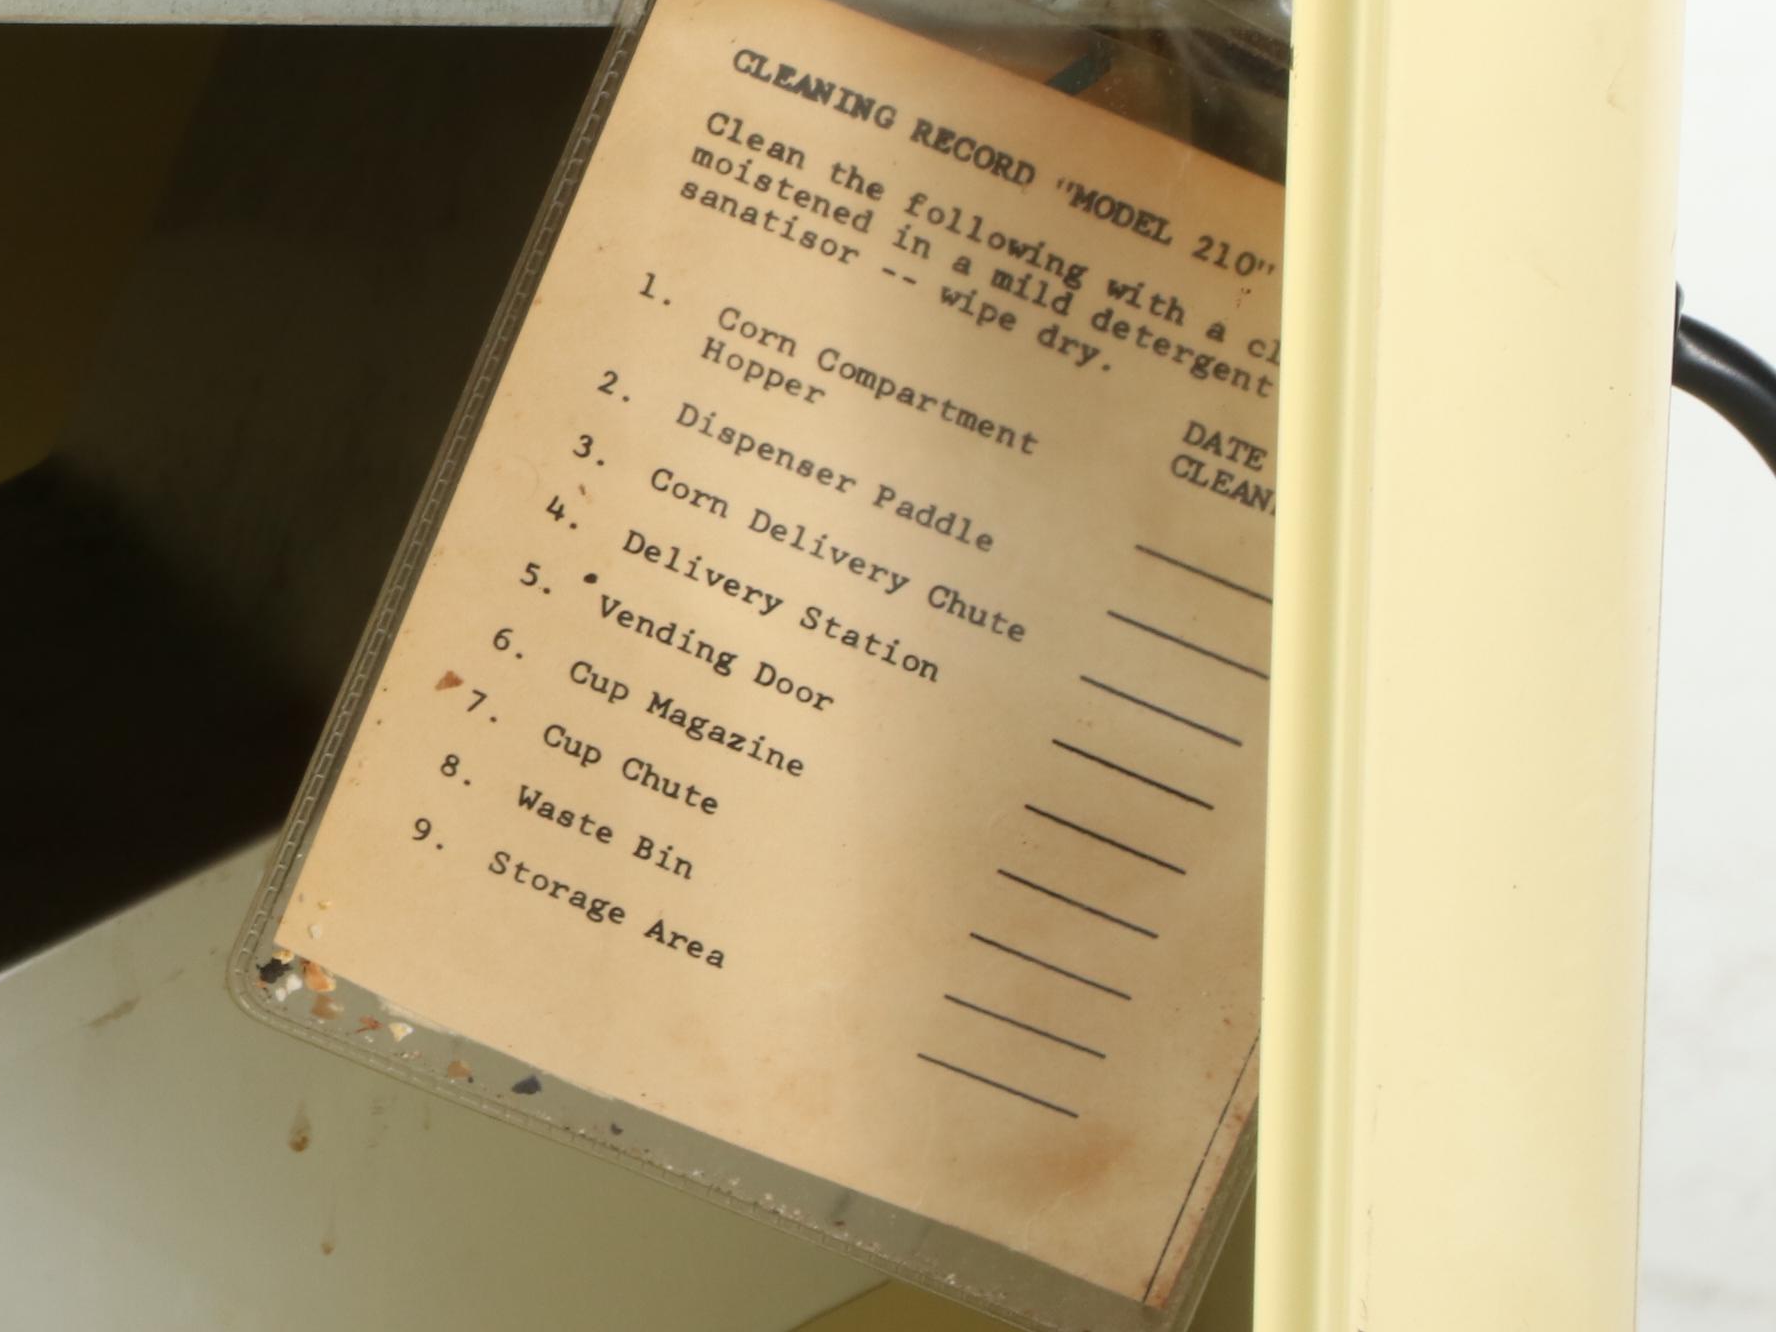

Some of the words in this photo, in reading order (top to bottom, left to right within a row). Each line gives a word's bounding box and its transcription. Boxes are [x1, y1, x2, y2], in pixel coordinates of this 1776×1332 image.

[706, 111, 806, 170] Clean
[830, 162, 885, 202] the
[905, 192, 1090, 294] following
[1106, 278, 1185, 327] with
[1205, 321, 1226, 344] a
[733, 48, 898, 130] CLEANING
[910, 119, 1036, 187] RECORD
[1056, 179, 1173, 246] "MODEL
[1191, 234, 1275, 277] 210"
[679, 181, 860, 265] sanatisor
[940, 286, 1018, 332] wipe
[1036, 323, 1111, 372] dry.
[691, 146, 875, 235] moistened
[892, 223, 931, 260] in
[951, 255, 972, 277] a
[990, 268, 1075, 317] mild
[1090, 307, 1273, 398] detergent
[639, 272, 671, 306] 1.
[718, 306, 797, 358] Corn
[817, 347, 1040, 456] Compartment
[700, 336, 826, 404] Hopper
[1182, 420, 1268, 472] DATE
[572, 434, 605, 467] 3.
[650, 467, 728, 519] Corn
[748, 507, 911, 596] Delivery
[927, 584, 1026, 643] Chute
[596, 370, 630, 403] 2.
[675, 402, 857, 494] Dispenser
[872, 484, 994, 553] Paddle
[1170, 453, 1276, 516] CLEAN
[519, 561, 551, 595] 5.
[601, 594, 738, 677] Vending
[753, 661, 835, 712] Door
[545, 495, 578, 530] 4.
[621, 529, 784, 616] Delivery
[799, 606, 939, 683] Station
[466, 689, 497, 723] 7.
[543, 724, 602, 768] Cup
[621, 757, 718, 815] Chute
[492, 627, 523, 660] 6.
[569, 660, 630, 704] Cup
[645, 691, 804, 777] Magazine
[412, 817, 444, 851] 9.
[487, 850, 626, 925] Storage
[643, 918, 725, 969] Area
[439, 753, 471, 786] 8.
[518, 784, 613, 845] Waste
[632, 835, 693, 880] Bin
